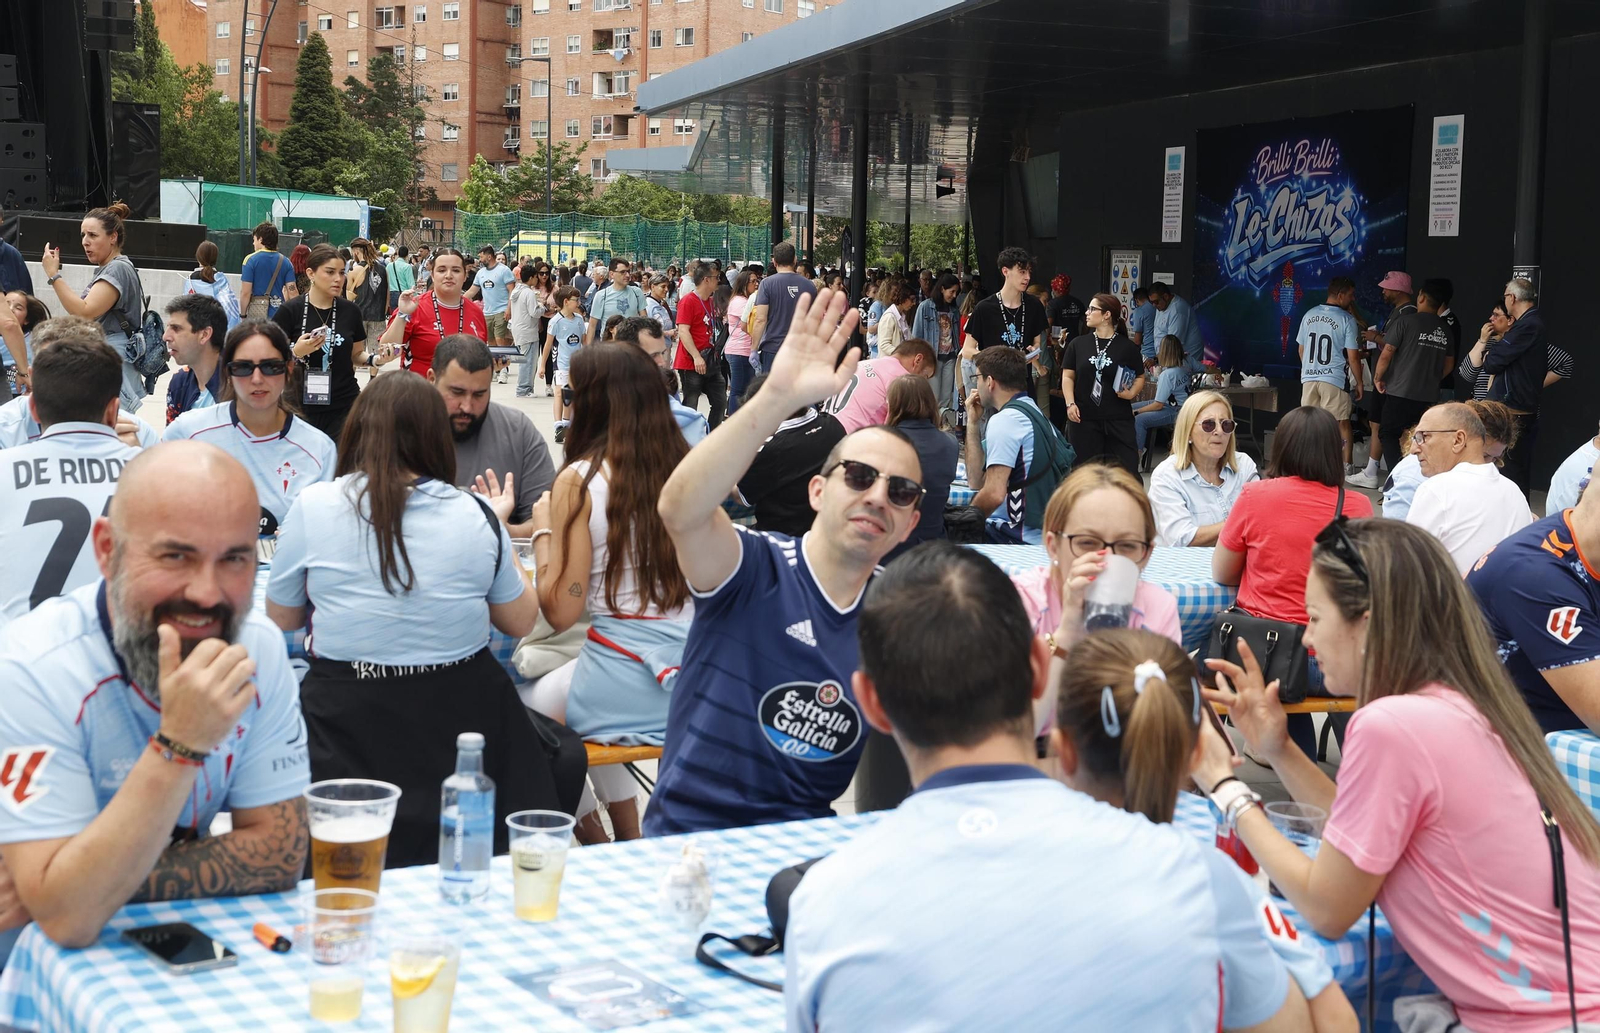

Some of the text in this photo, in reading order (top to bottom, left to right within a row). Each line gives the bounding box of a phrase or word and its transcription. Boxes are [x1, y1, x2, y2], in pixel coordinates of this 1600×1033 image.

[1255, 138, 1335, 184] Brilli Brilli
[1306, 315, 1339, 331] IAGO ASPAS
[1308, 332, 1333, 366] 10
[13, 457, 129, 490] DE RIDD
[773, 709, 838, 751] Galicia
[777, 690, 852, 734] Estrella
